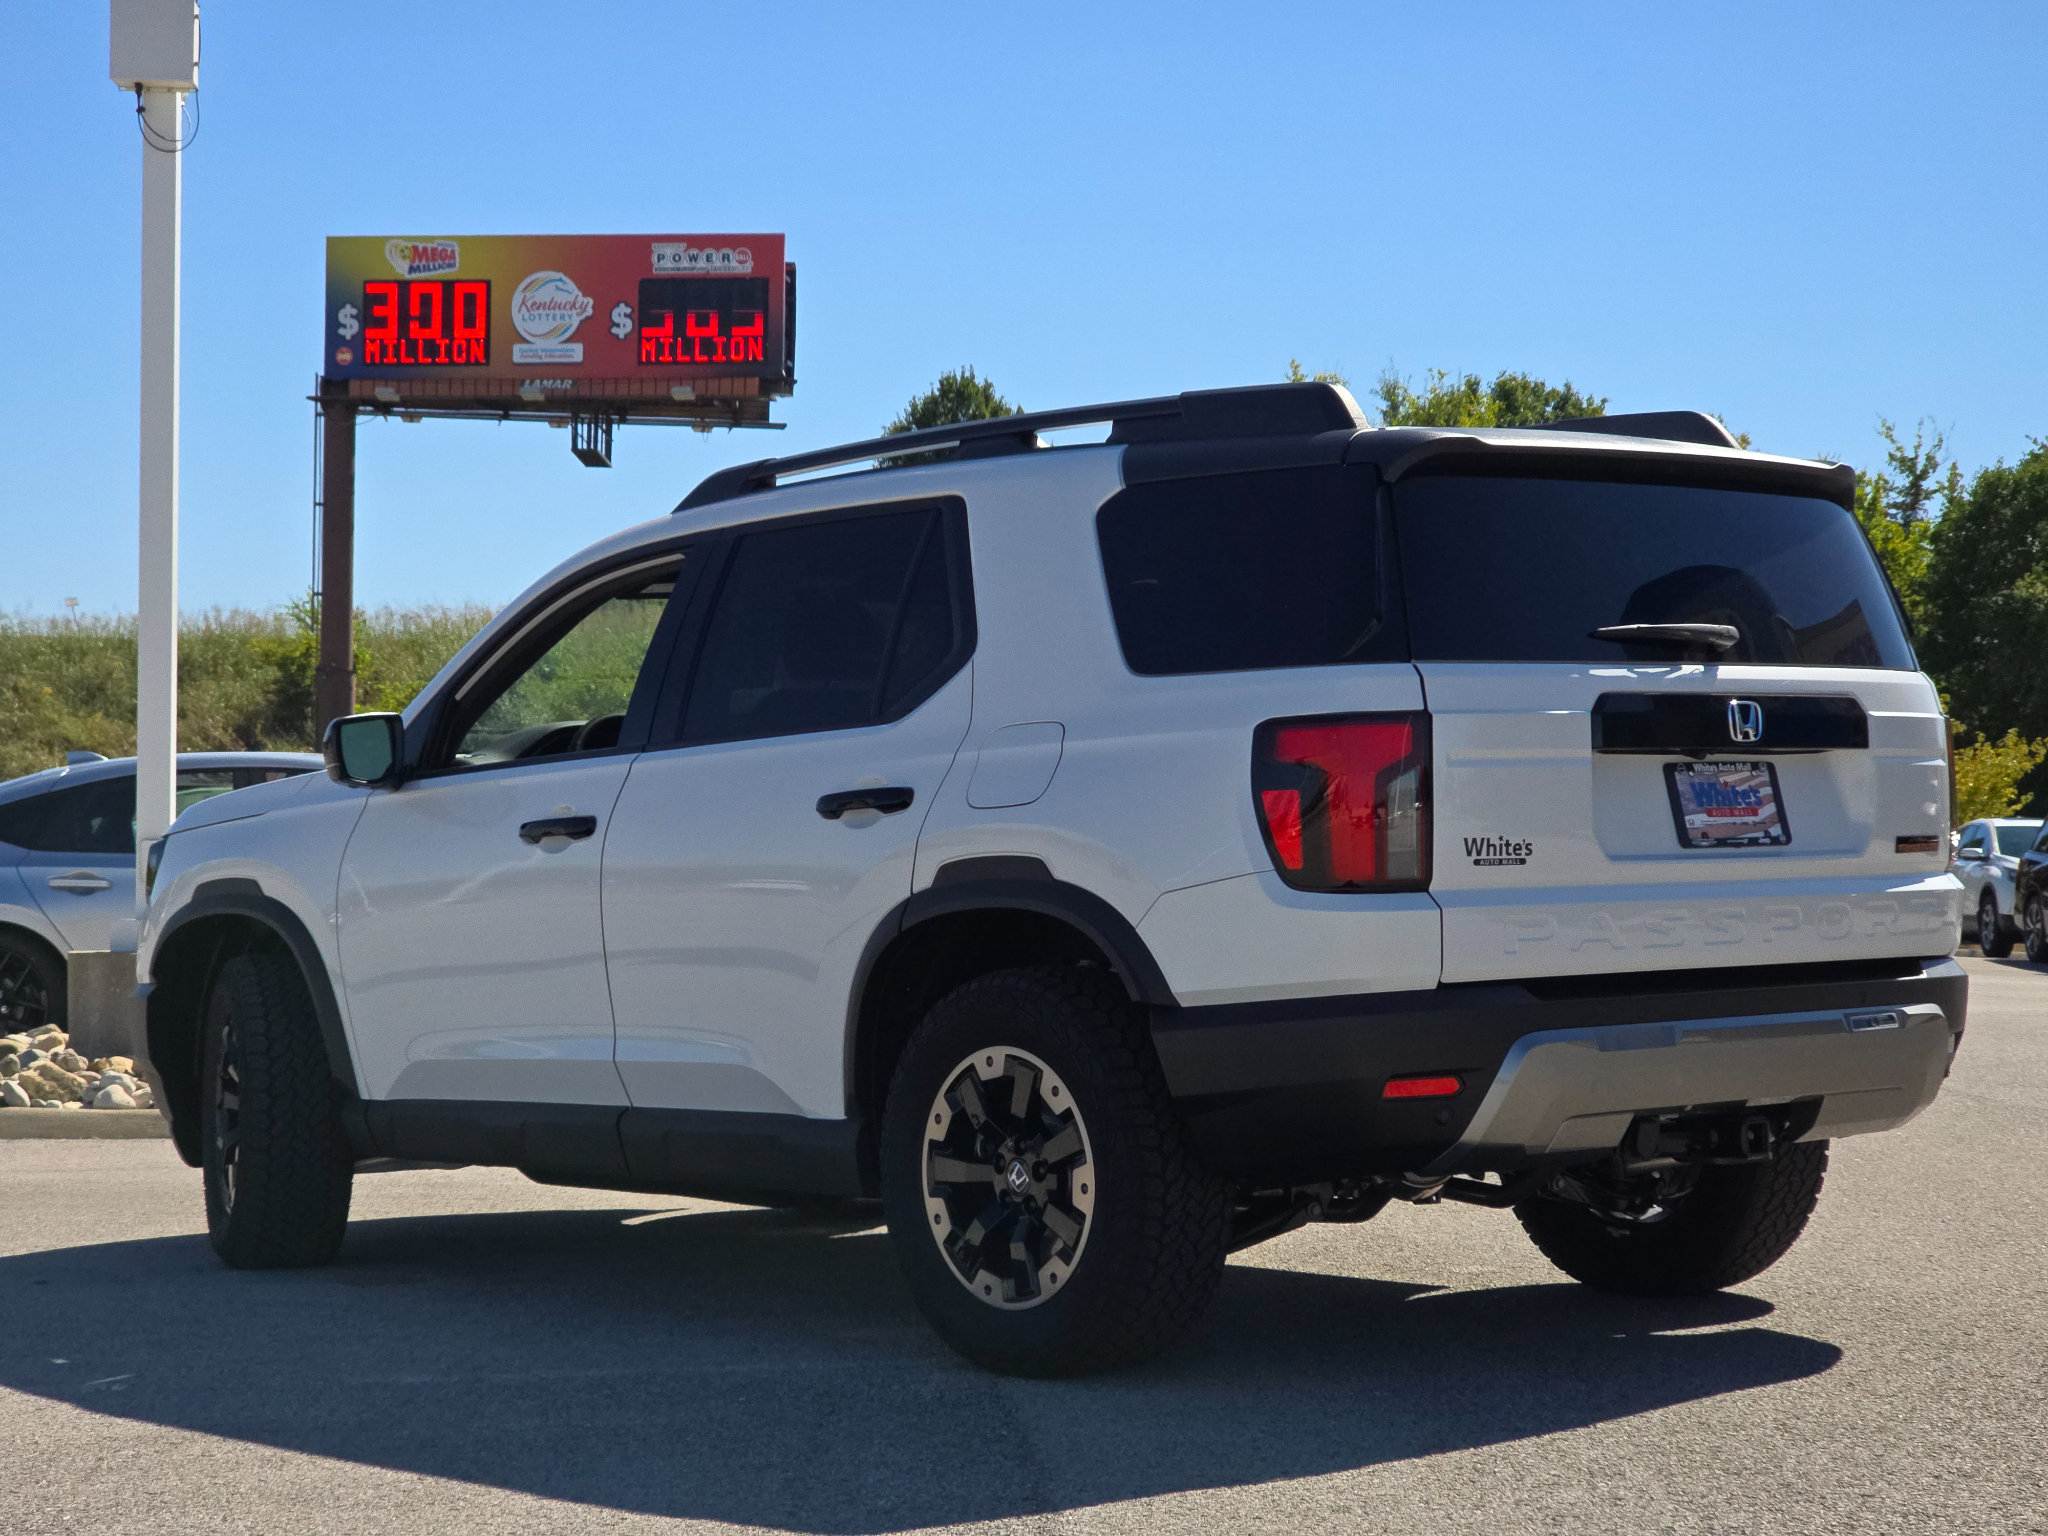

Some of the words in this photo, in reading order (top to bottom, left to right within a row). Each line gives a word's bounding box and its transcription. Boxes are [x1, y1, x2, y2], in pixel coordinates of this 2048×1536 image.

[410, 244, 456, 264] MEGA
[656, 252, 731, 264] POWER
[518, 294, 590, 316] Kentucky
[521, 313, 574, 322] LOTTERY
[365, 339, 486, 364] MILLION
[641, 337, 764, 363] MILLION
[523, 379, 574, 390] LAMAR
[1719, 763, 1735, 771] Auto
[1736, 763, 1752, 771] Mall
[1689, 781, 1763, 807] White's
[1734, 808, 1753, 816] MALL
[1463, 835, 1533, 857] White's
[1480, 858, 1499, 866] AUTO
